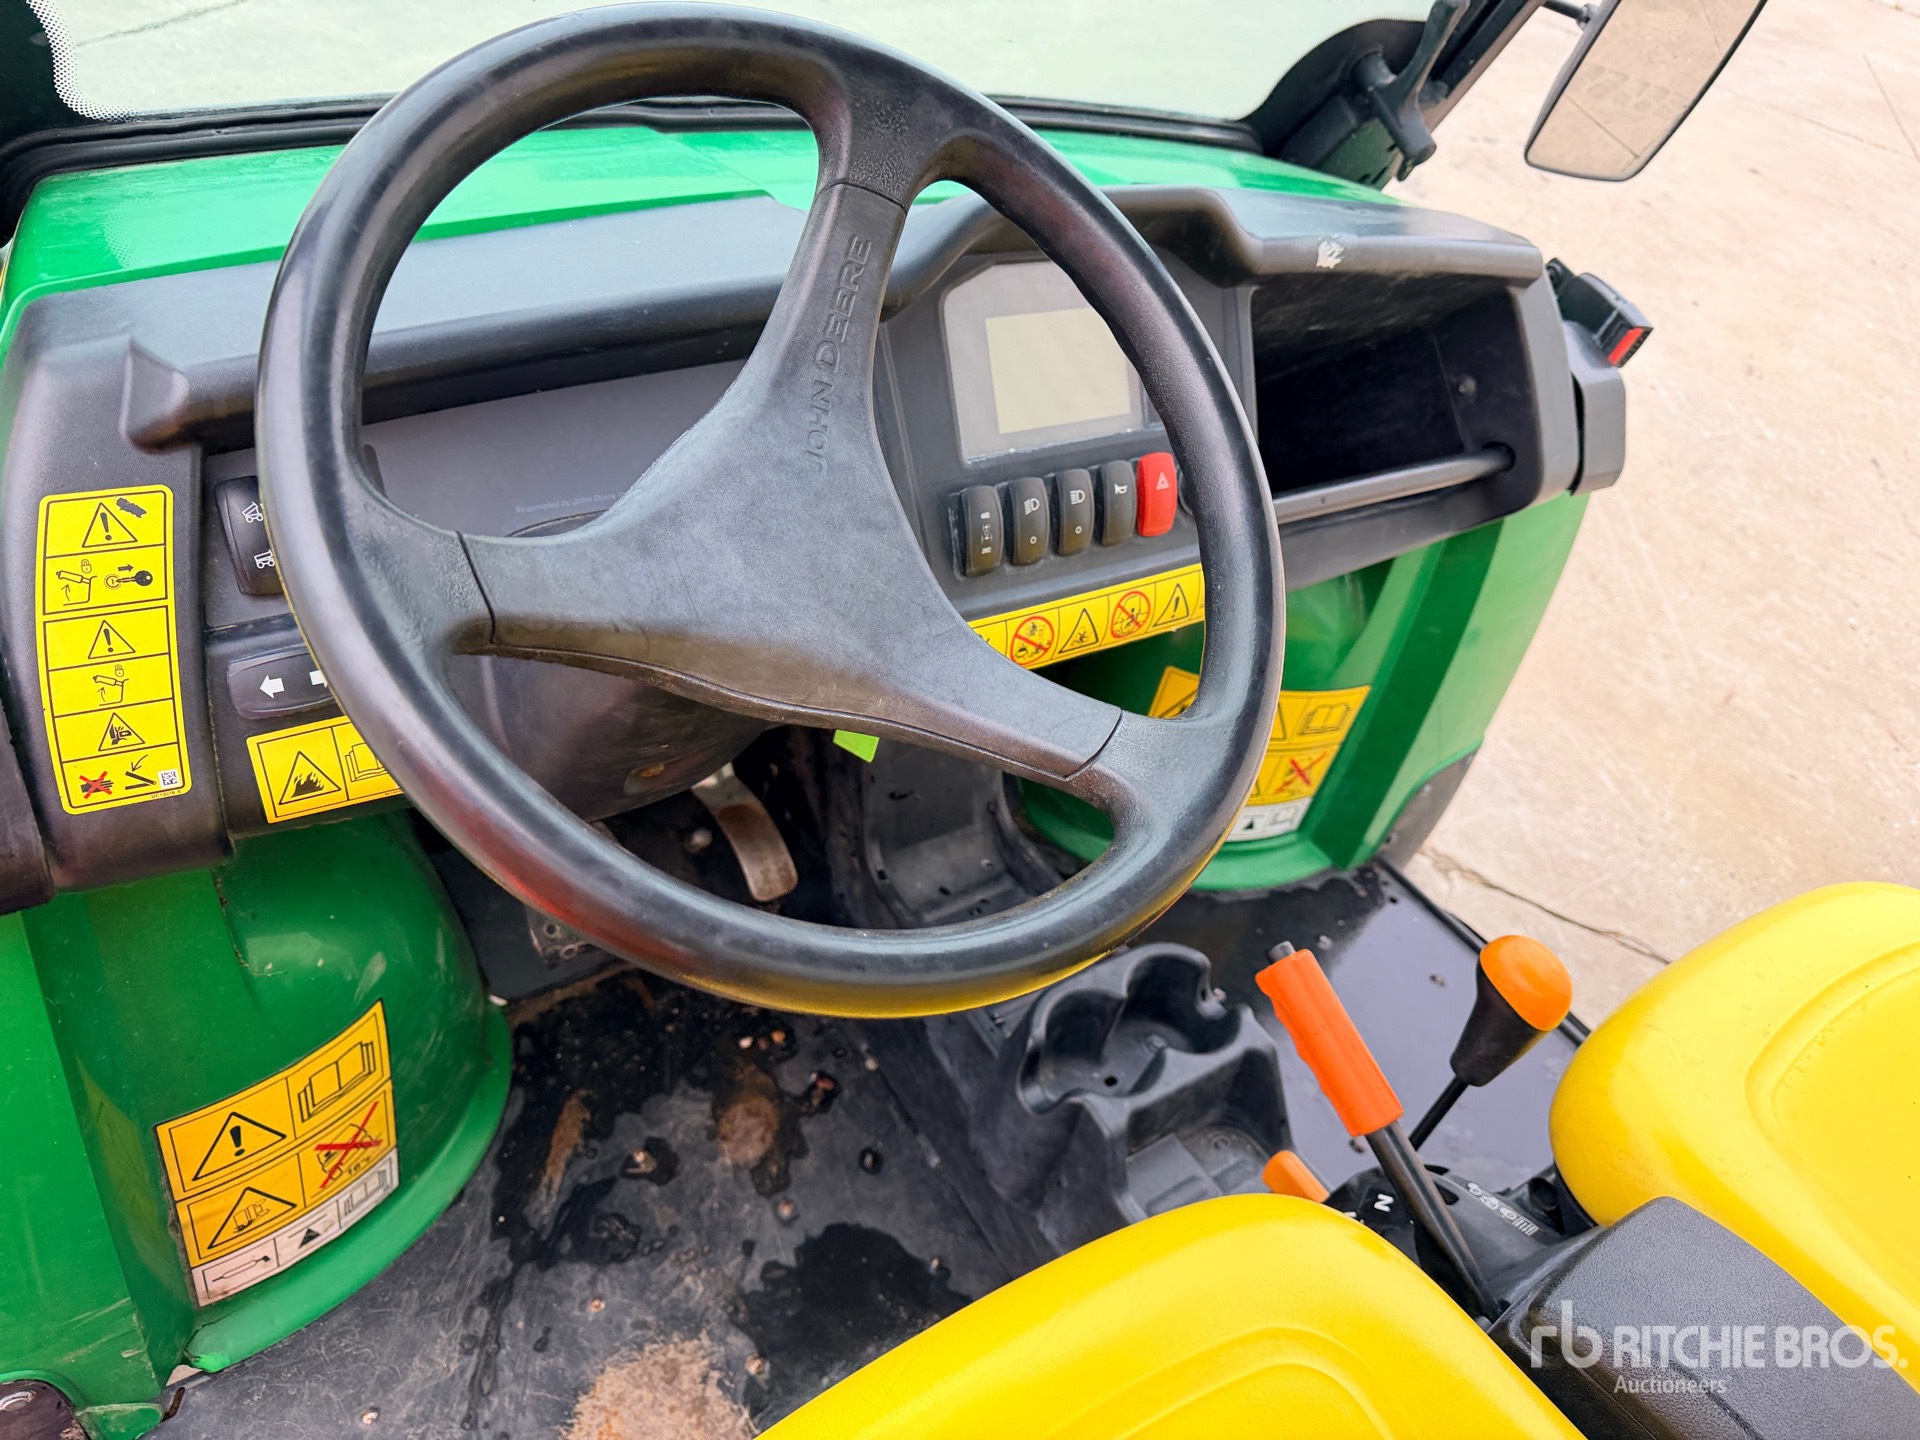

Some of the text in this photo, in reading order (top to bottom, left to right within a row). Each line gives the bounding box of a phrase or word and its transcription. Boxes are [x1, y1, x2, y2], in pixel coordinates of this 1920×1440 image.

[805, 234, 872, 476] JOHN DEERE
[1374, 1193, 1394, 1212] N
